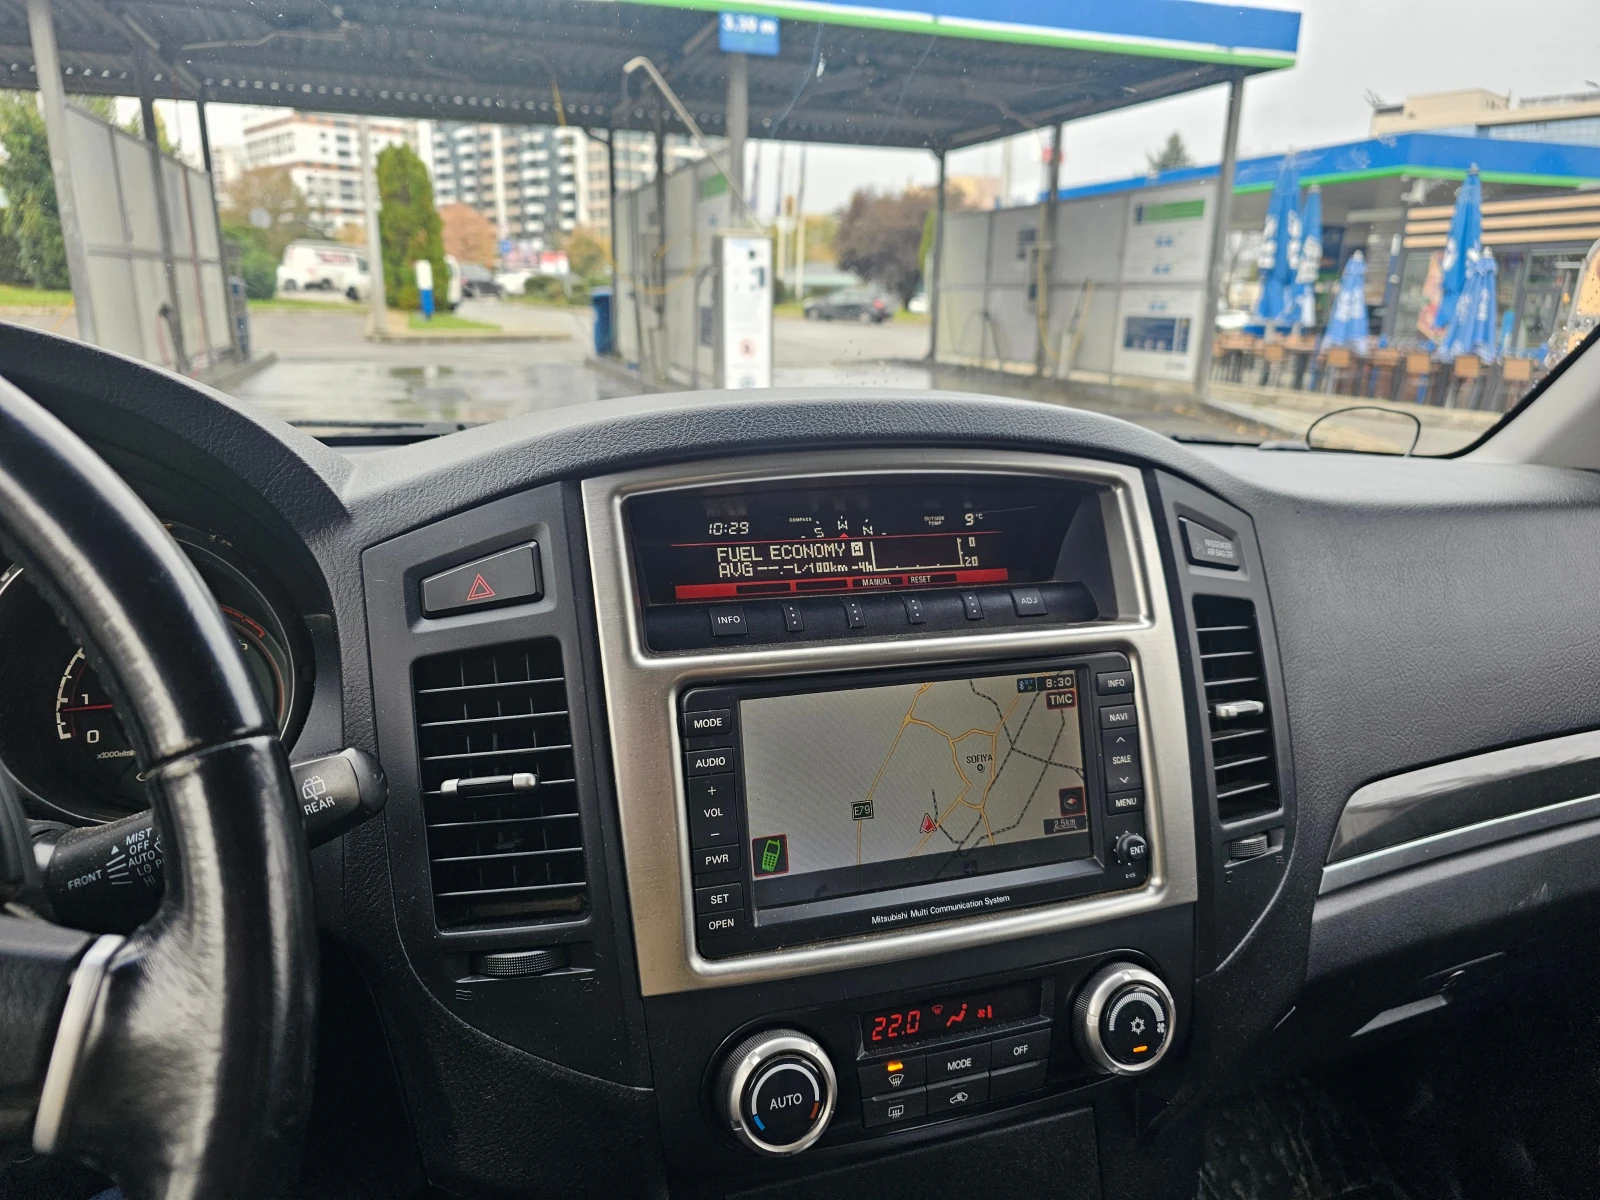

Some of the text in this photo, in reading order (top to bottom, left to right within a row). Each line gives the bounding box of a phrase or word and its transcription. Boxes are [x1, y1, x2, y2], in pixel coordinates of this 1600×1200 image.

[709, 521, 749, 536] 10:29
[814, 520, 873, 538] S W N
[969, 536, 976, 547] 0
[717, 546, 763, 562] FUEL
[769, 542, 846, 560] ECONOMY
[965, 556, 979, 567] 20
[718, 562, 753, 578] AVG
[862, 578, 892, 586] MANUAL
[910, 575, 931, 583] RESET
[1021, 597, 1038, 605] ADJ
[717, 615, 741, 624] INFO
[1045, 677, 1073, 688] 8:30
[1107, 679, 1125, 688] INFO
[81, 693, 89, 705] 1
[1049, 693, 1073, 705] TMC
[1109, 712, 1128, 722] NAVI
[693, 718, 723, 729] MODE
[86, 729, 100, 743] 0
[695, 756, 726, 768] AUDIO
[966, 753, 993, 764] SOFIYA
[1112, 754, 1132, 764] SCALE
[303, 796, 335, 815] REAR
[1115, 797, 1137, 807] MENU
[703, 807, 724, 818] VOL
[854, 805, 870, 816] E79
[1053, 819, 1076, 828] 2.5km
[126, 827, 153, 846] MIST
[129, 840, 150, 855] OFF
[1130, 845, 1145, 855] ENT
[128, 850, 156, 868] AUTO
[705, 854, 729, 865] PWR
[136, 863, 152, 876] LO
[67, 869, 103, 890] FRONT
[143, 875, 156, 887] HI
[710, 893, 730, 905] SET
[871, 894, 1011, 925] Mitsubishi Multi Communication System
[708, 918, 735, 930] OPEN
[872, 1009, 921, 1041] 22.0
[1013, 1044, 1029, 1056] OFF
[947, 1057, 972, 1071] MODE
[770, 1093, 803, 1110] AUTO
